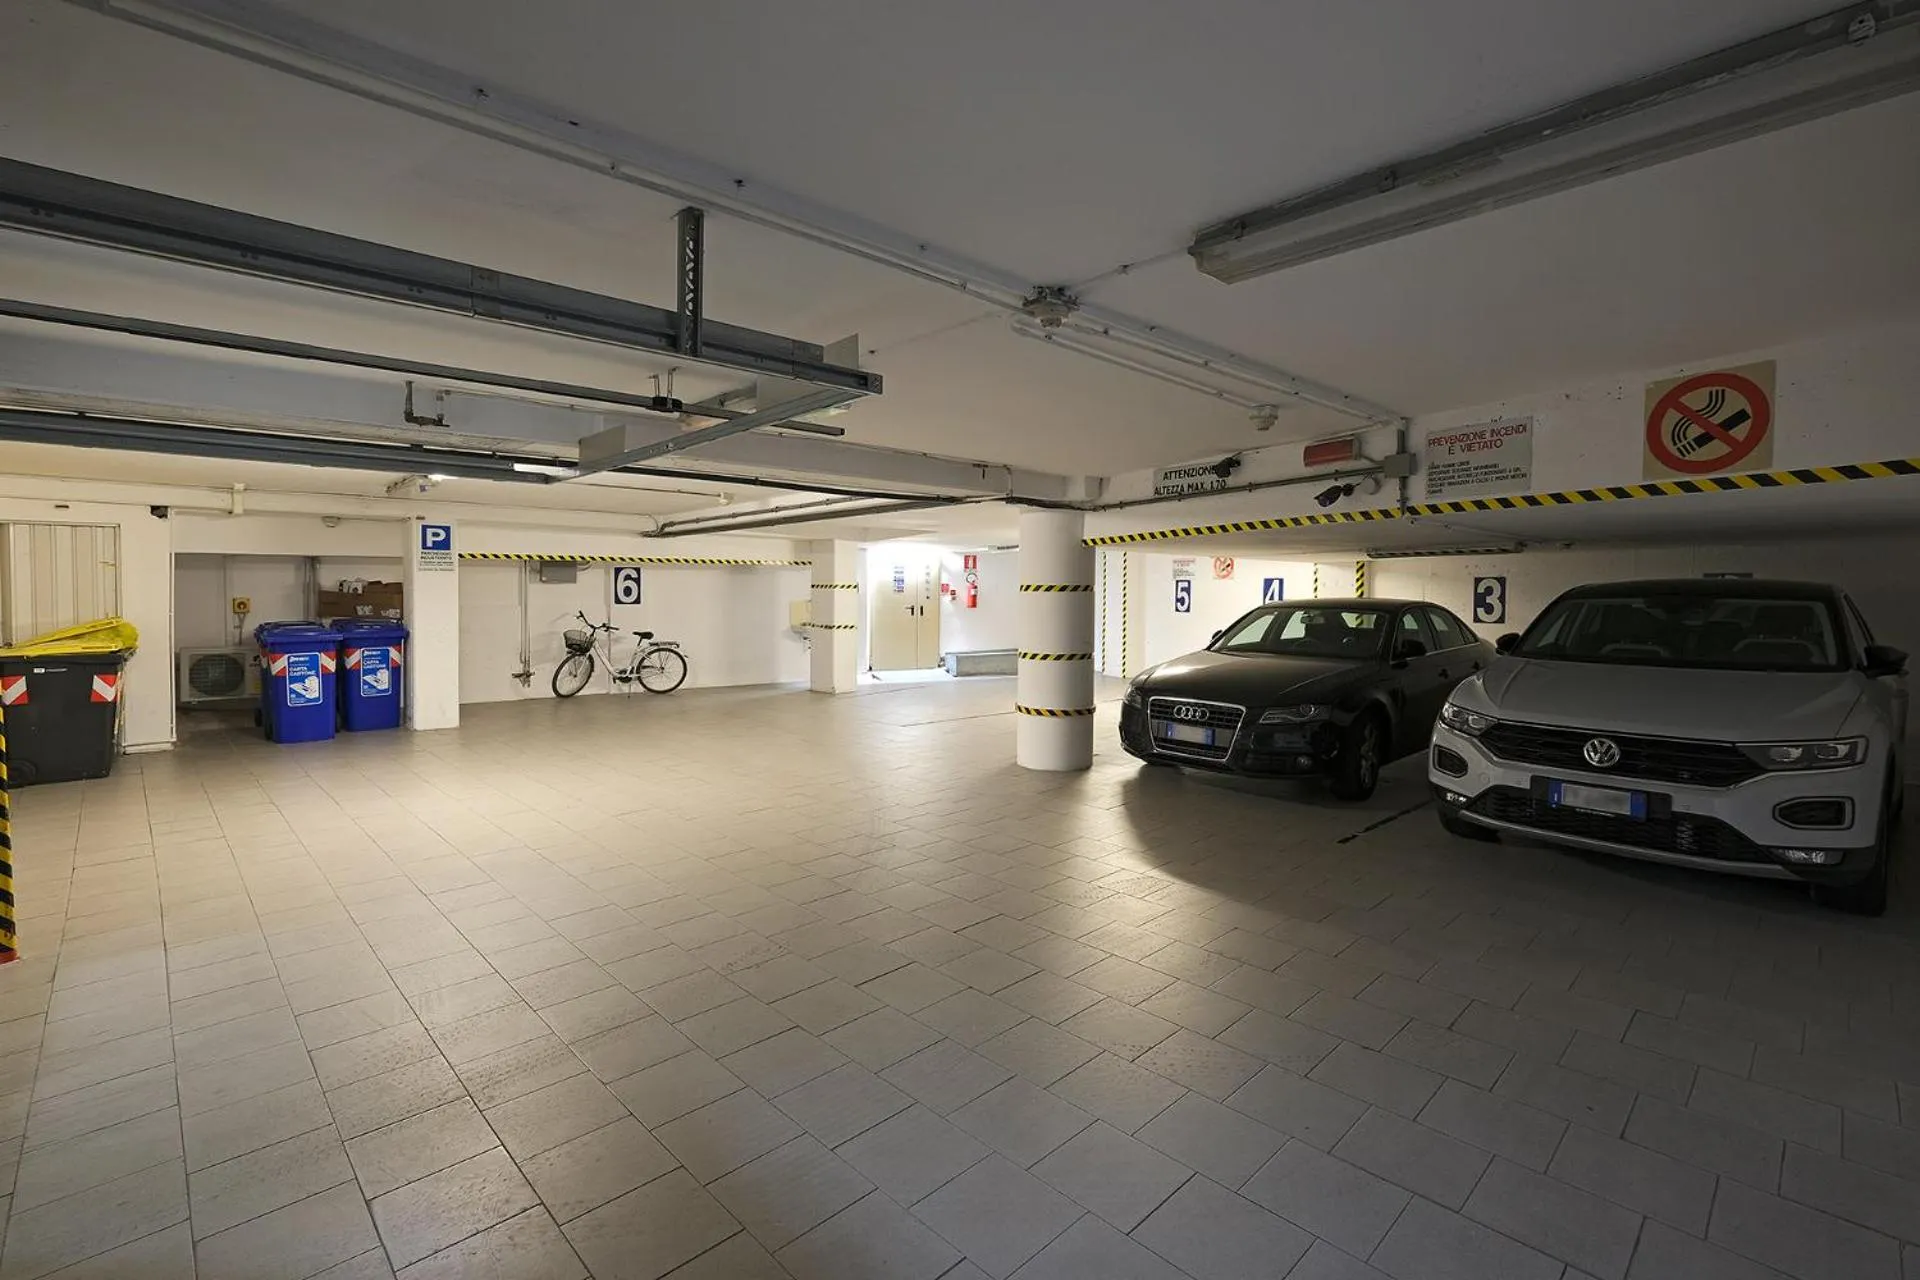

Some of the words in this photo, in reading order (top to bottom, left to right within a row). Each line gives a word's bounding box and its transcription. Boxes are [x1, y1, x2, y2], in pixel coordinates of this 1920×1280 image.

[1428, 430, 1486, 447] PREVENZIONE
[1490, 424, 1527, 437] INCENDI
[1460, 438, 1503, 453] VIETATO
[1154, 484, 1185, 496] ALTEZZA
[426, 528, 446, 547] P
[616, 568, 638, 604] 6
[1176, 581, 1189, 612] 5
[1264, 579, 1280, 604] 4
[1476, 578, 1503, 623] 3
